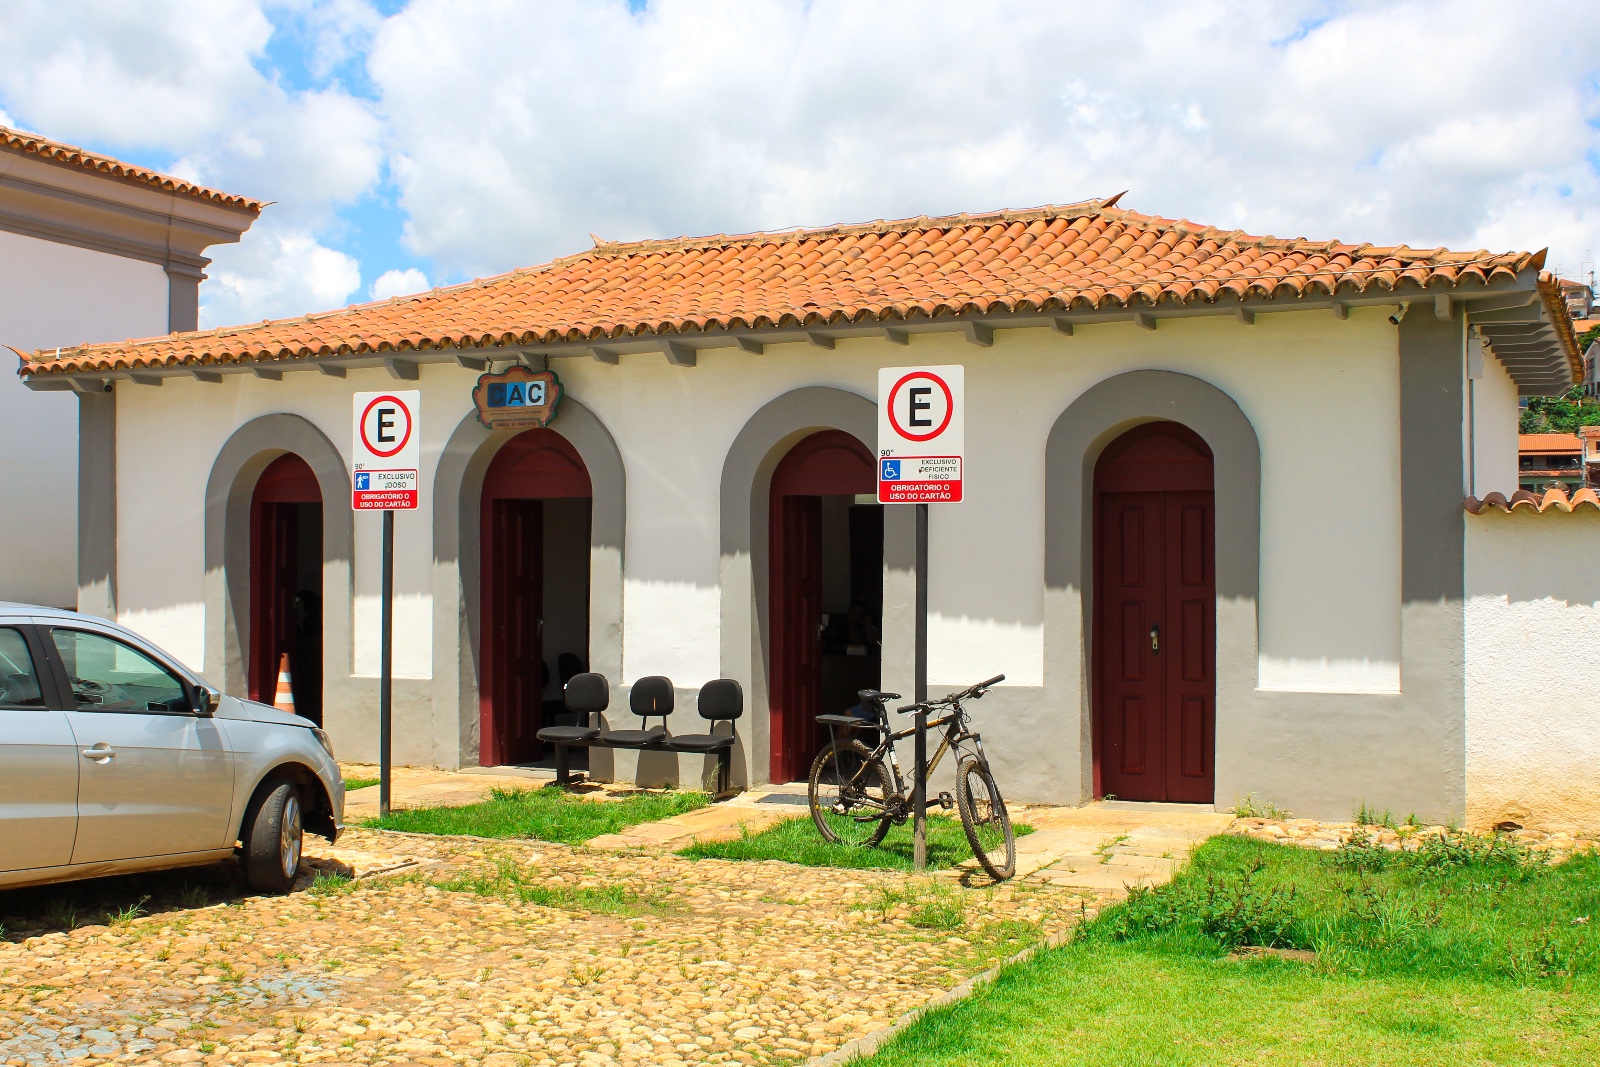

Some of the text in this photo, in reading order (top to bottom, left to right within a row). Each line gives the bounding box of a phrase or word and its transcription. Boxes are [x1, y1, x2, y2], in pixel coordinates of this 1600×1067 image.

[490, 384, 542, 404] CAC
[909, 387, 932, 427] E
[377, 408, 396, 443] E
[385, 481, 407, 489] DOSO
[890, 483, 942, 492] OBRIGATÓRIO
[361, 492, 403, 500] OBRIGATÓRIO
[889, 492, 906, 500] USO
[919, 491, 951, 500] CARTÃO
[384, 500, 411, 508] CARTÃO
